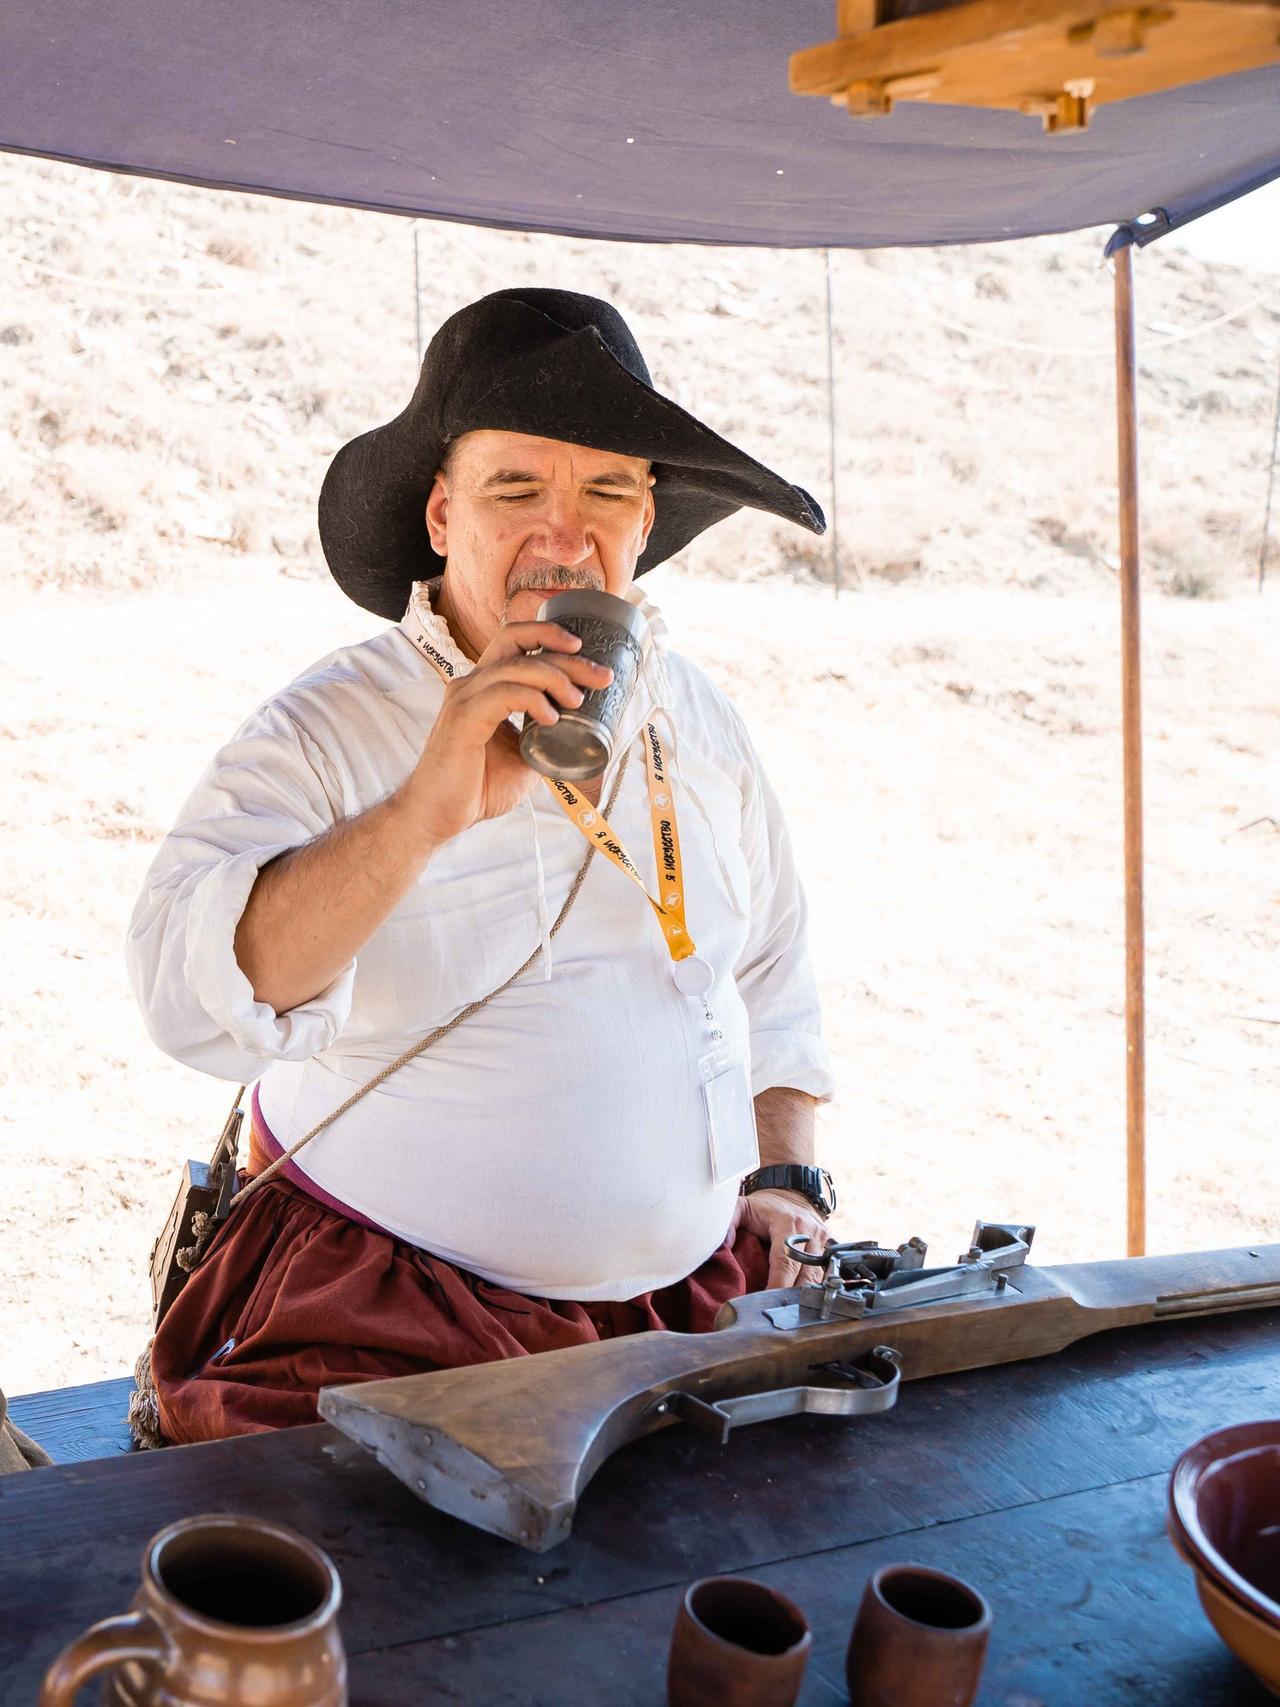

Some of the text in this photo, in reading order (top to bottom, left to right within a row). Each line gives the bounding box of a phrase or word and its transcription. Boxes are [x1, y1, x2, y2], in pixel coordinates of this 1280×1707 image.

[416, 635, 424, 643] Я
[654, 773, 665, 784] Я
[595, 831, 607, 839] Я
[660, 820, 677, 883] Я ИСКУССТВО
